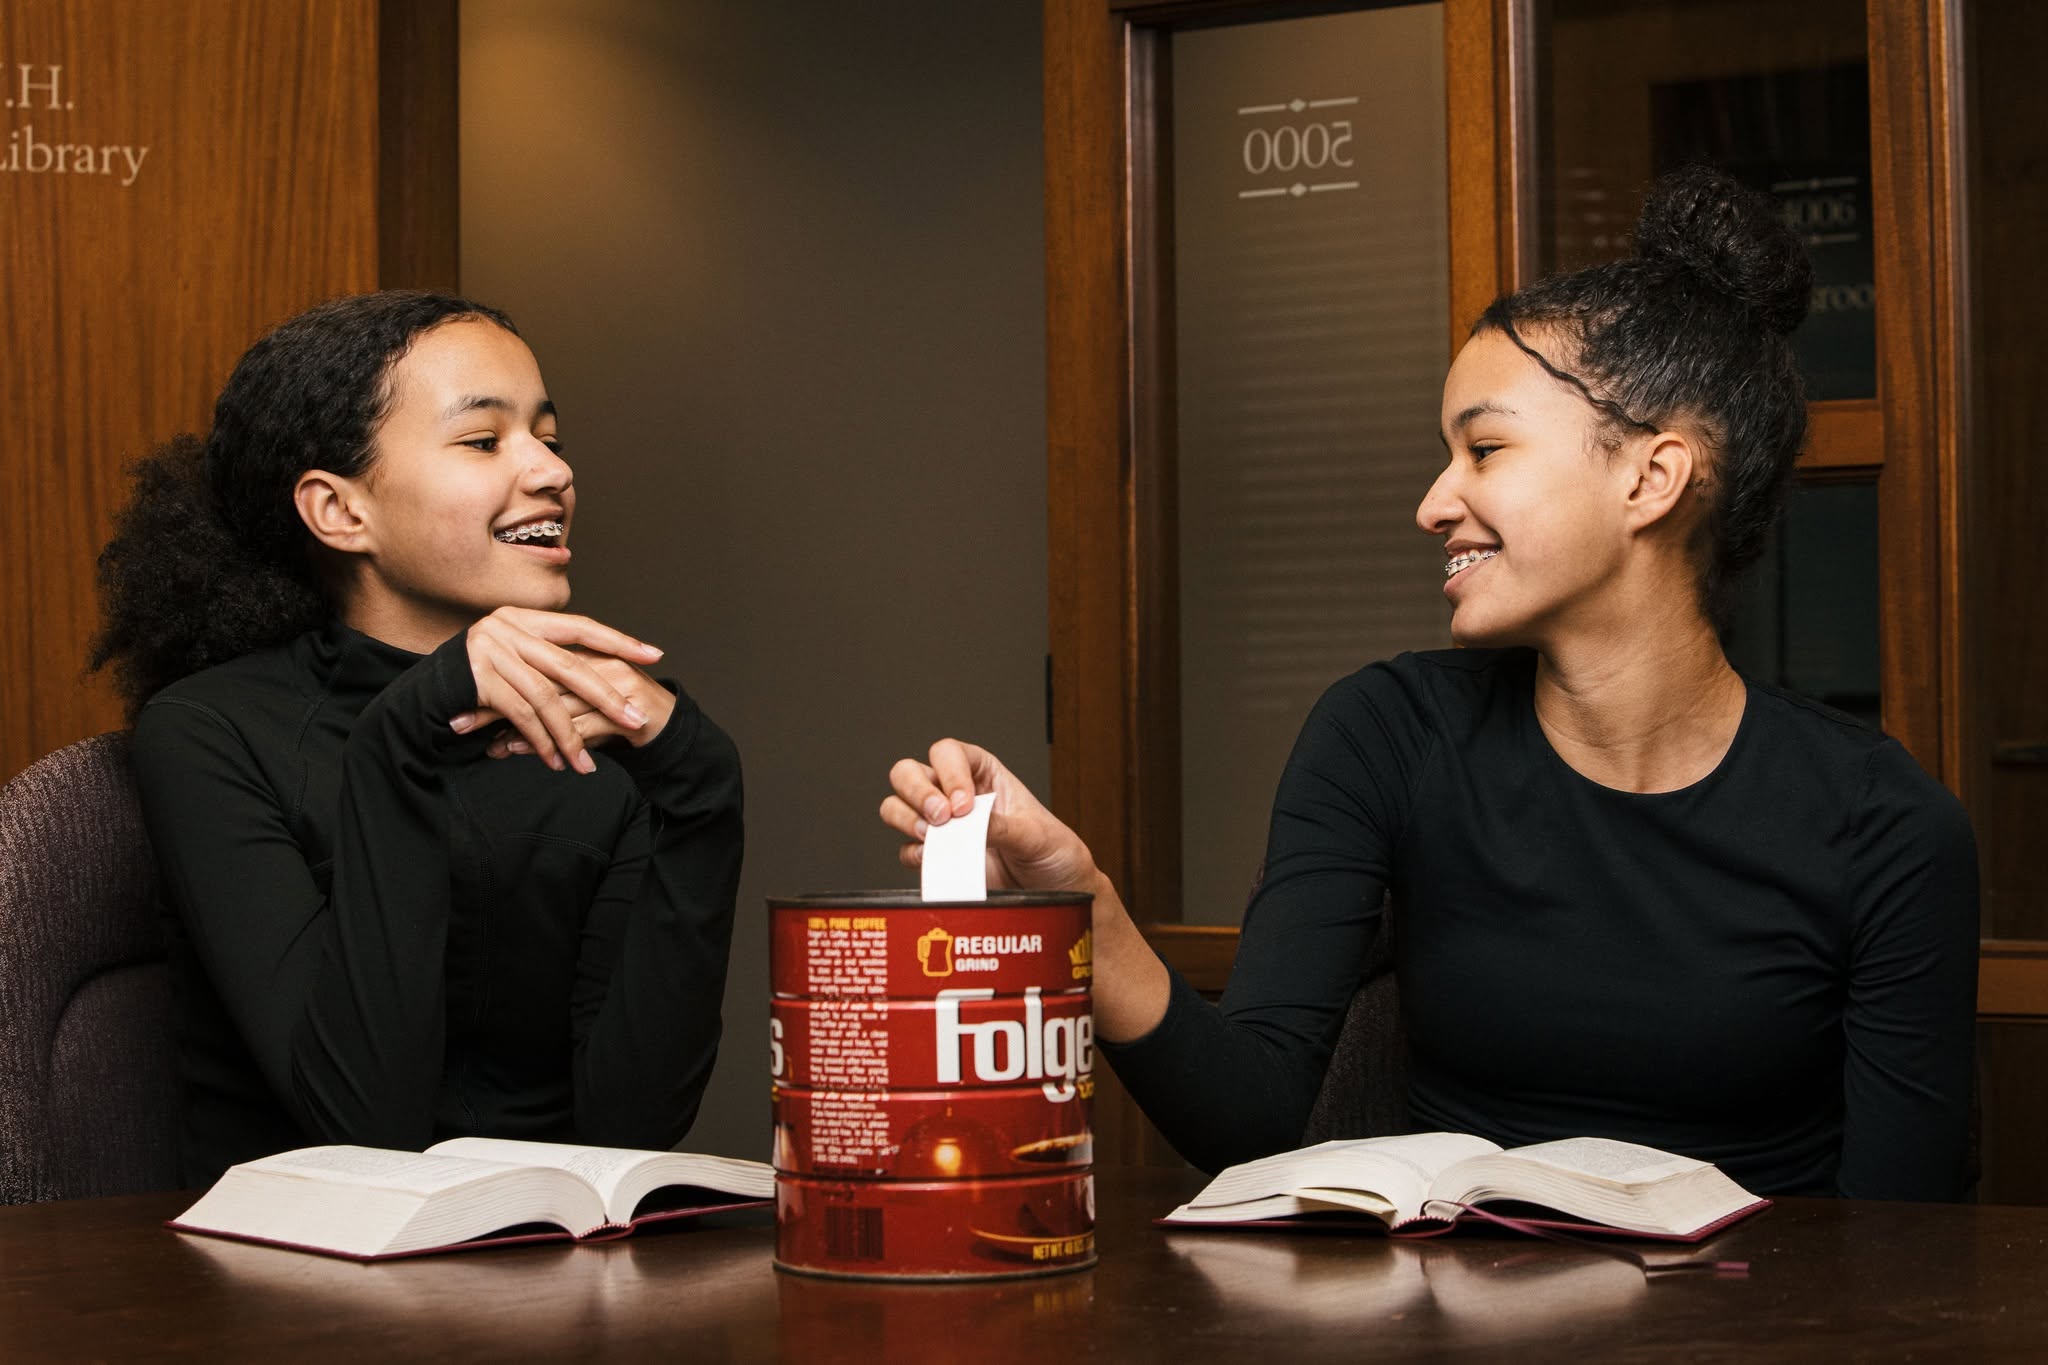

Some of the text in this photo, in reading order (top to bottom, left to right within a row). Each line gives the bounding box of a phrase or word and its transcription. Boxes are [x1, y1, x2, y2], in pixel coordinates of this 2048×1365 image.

[0, 63, 74, 110] .H.
[852, 917, 888, 930] COFFEE
[955, 934, 1042, 955] REGULAR
[955, 957, 1000, 972] GRIND
[1033, 1244, 1049, 1260] NET
